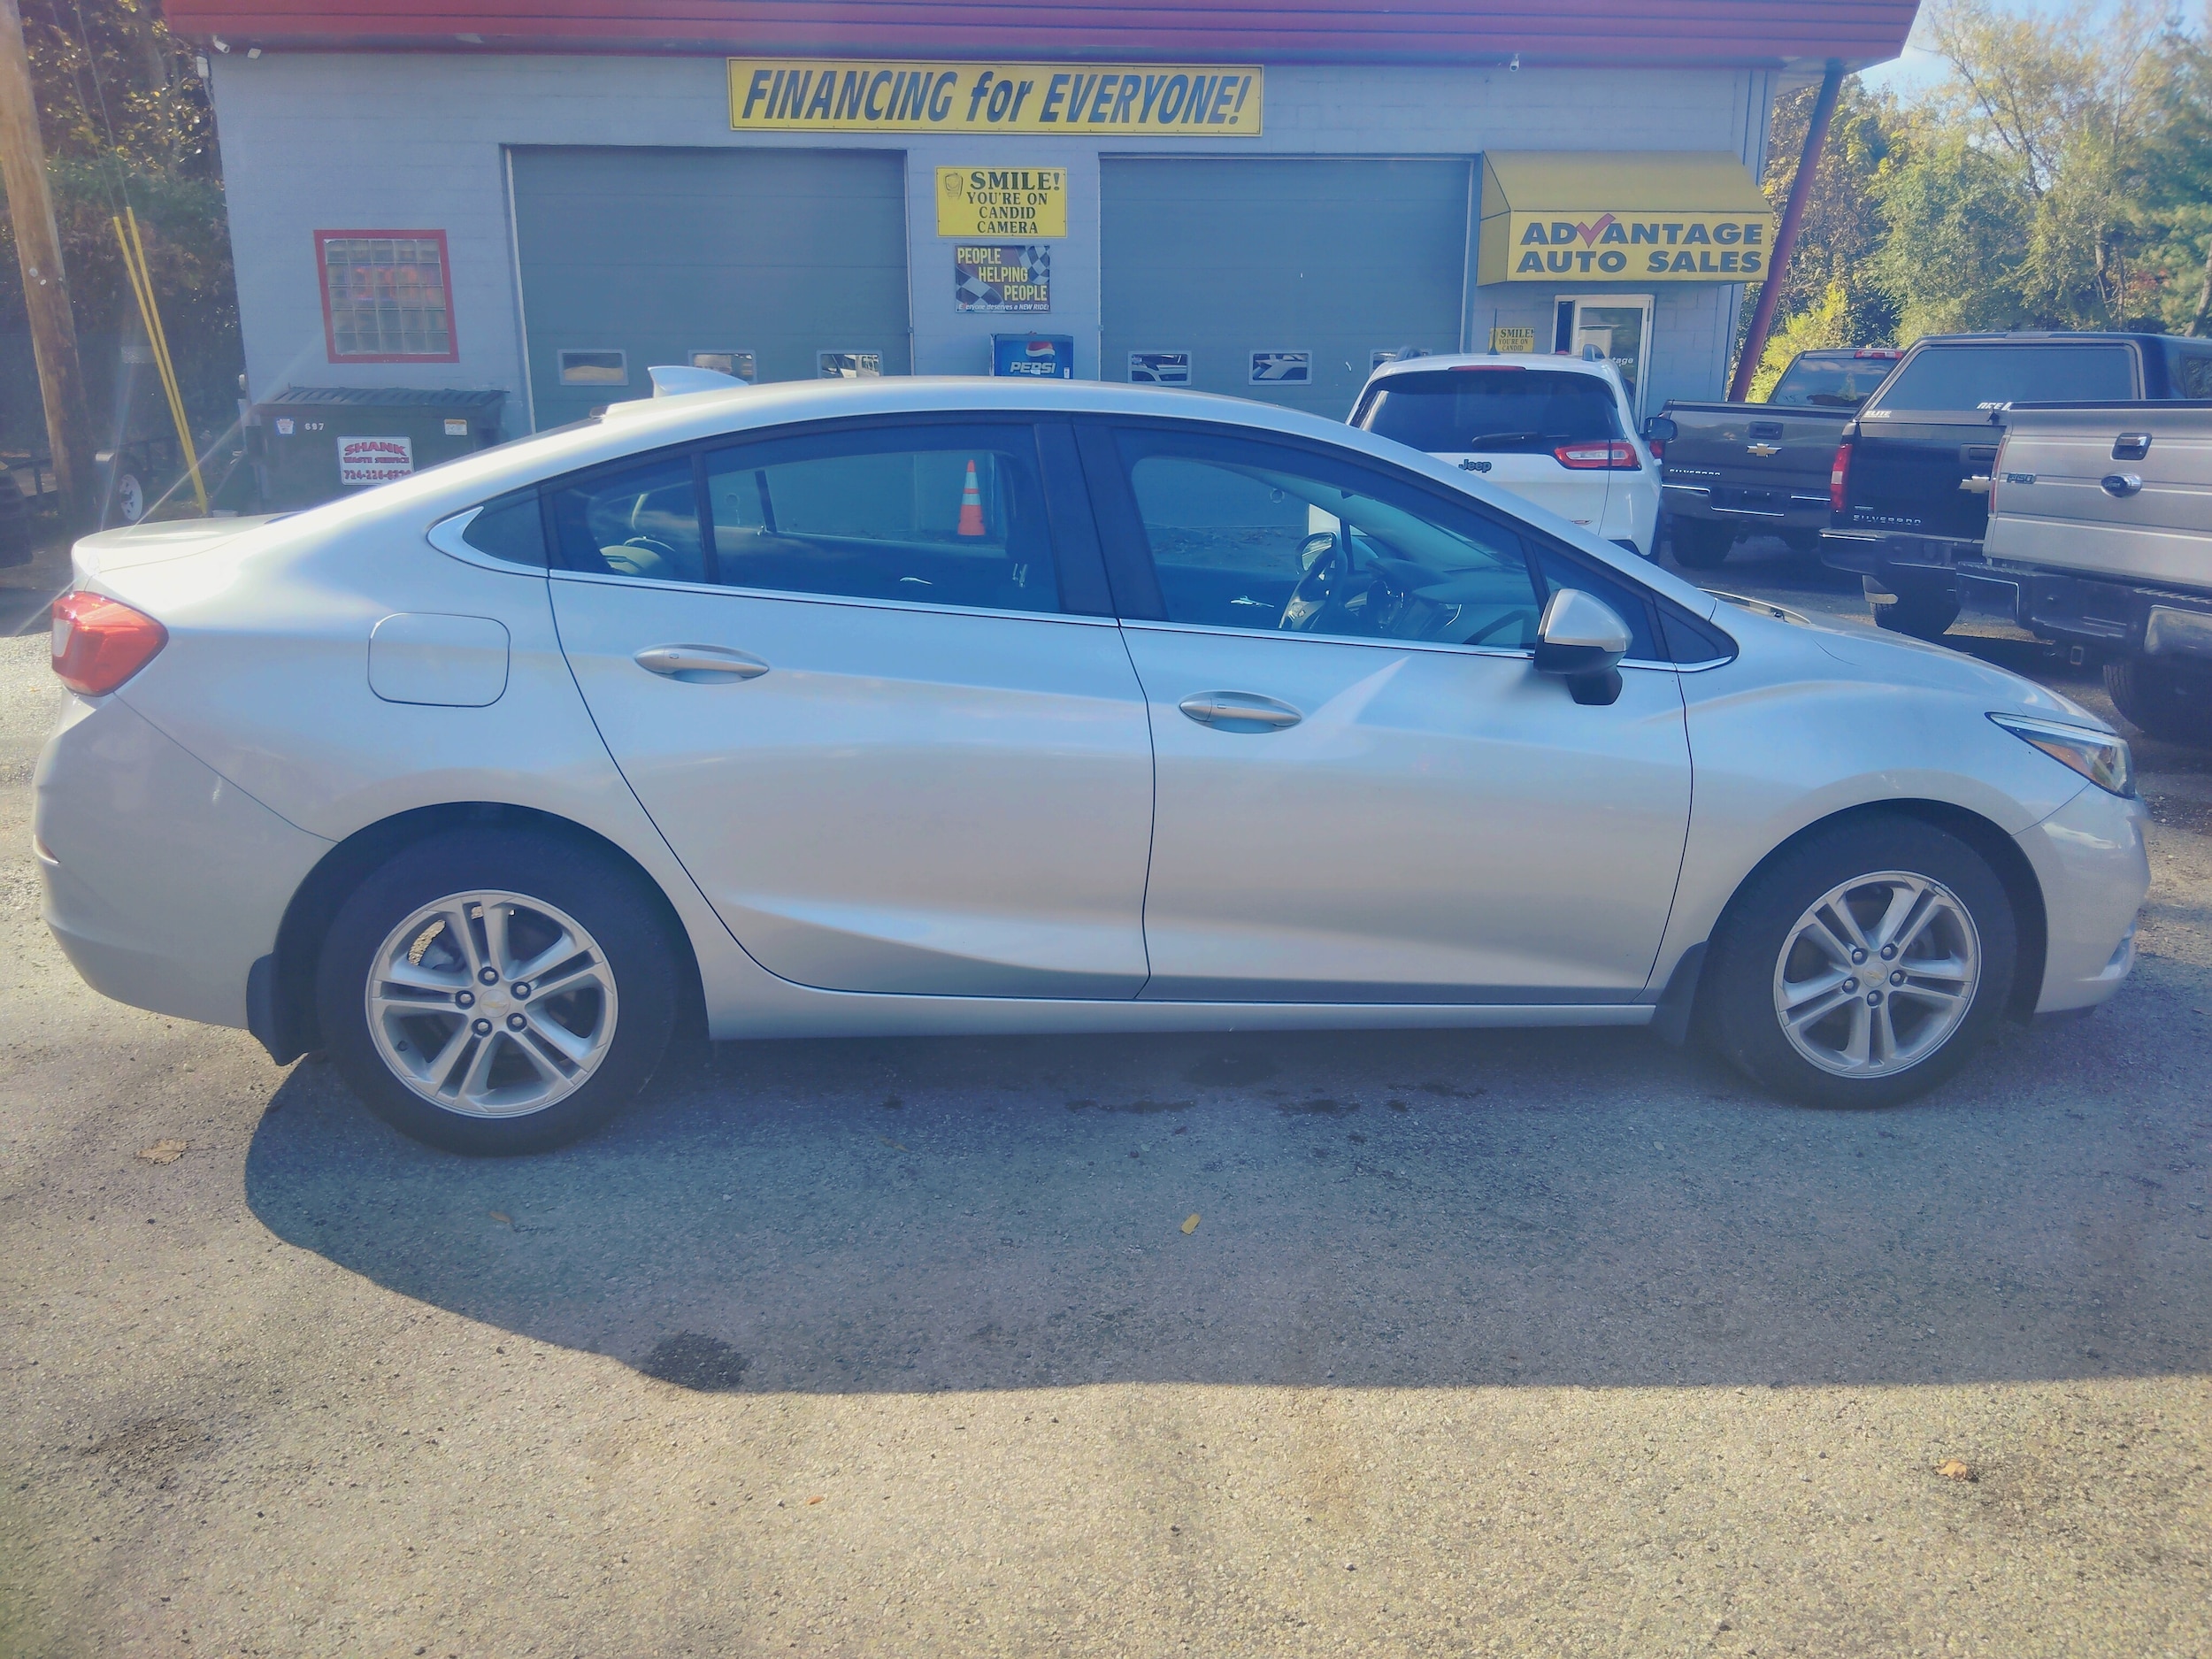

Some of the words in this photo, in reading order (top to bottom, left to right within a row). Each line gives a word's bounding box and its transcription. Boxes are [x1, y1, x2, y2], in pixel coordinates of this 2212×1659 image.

[742, 69, 958, 120] FINANCING
[965, 71, 1033, 122] for
[1039, 73, 1253, 125] EVERYONE!
[970, 171, 1060, 191] SMILE!
[966, 191, 1021, 205] YOU'RE
[1026, 192, 1048, 205] ON
[979, 206, 1036, 219] CANDID
[977, 220, 1039, 234] CAMERA
[1520, 219, 1763, 247] ADVANTAGE
[956, 248, 1002, 265] PEOPLE
[1516, 250, 1627, 273] AUTO
[1647, 250, 1763, 273] SALES
[978, 266, 1028, 282] HELPING
[1003, 284, 1048, 302] PEOPLE
[1500, 328, 1534, 338] SMILE!
[1010, 361, 1056, 374] PEPSI
[344, 441, 407, 457] SHANK
[1458, 458, 1492, 473] Jeep
